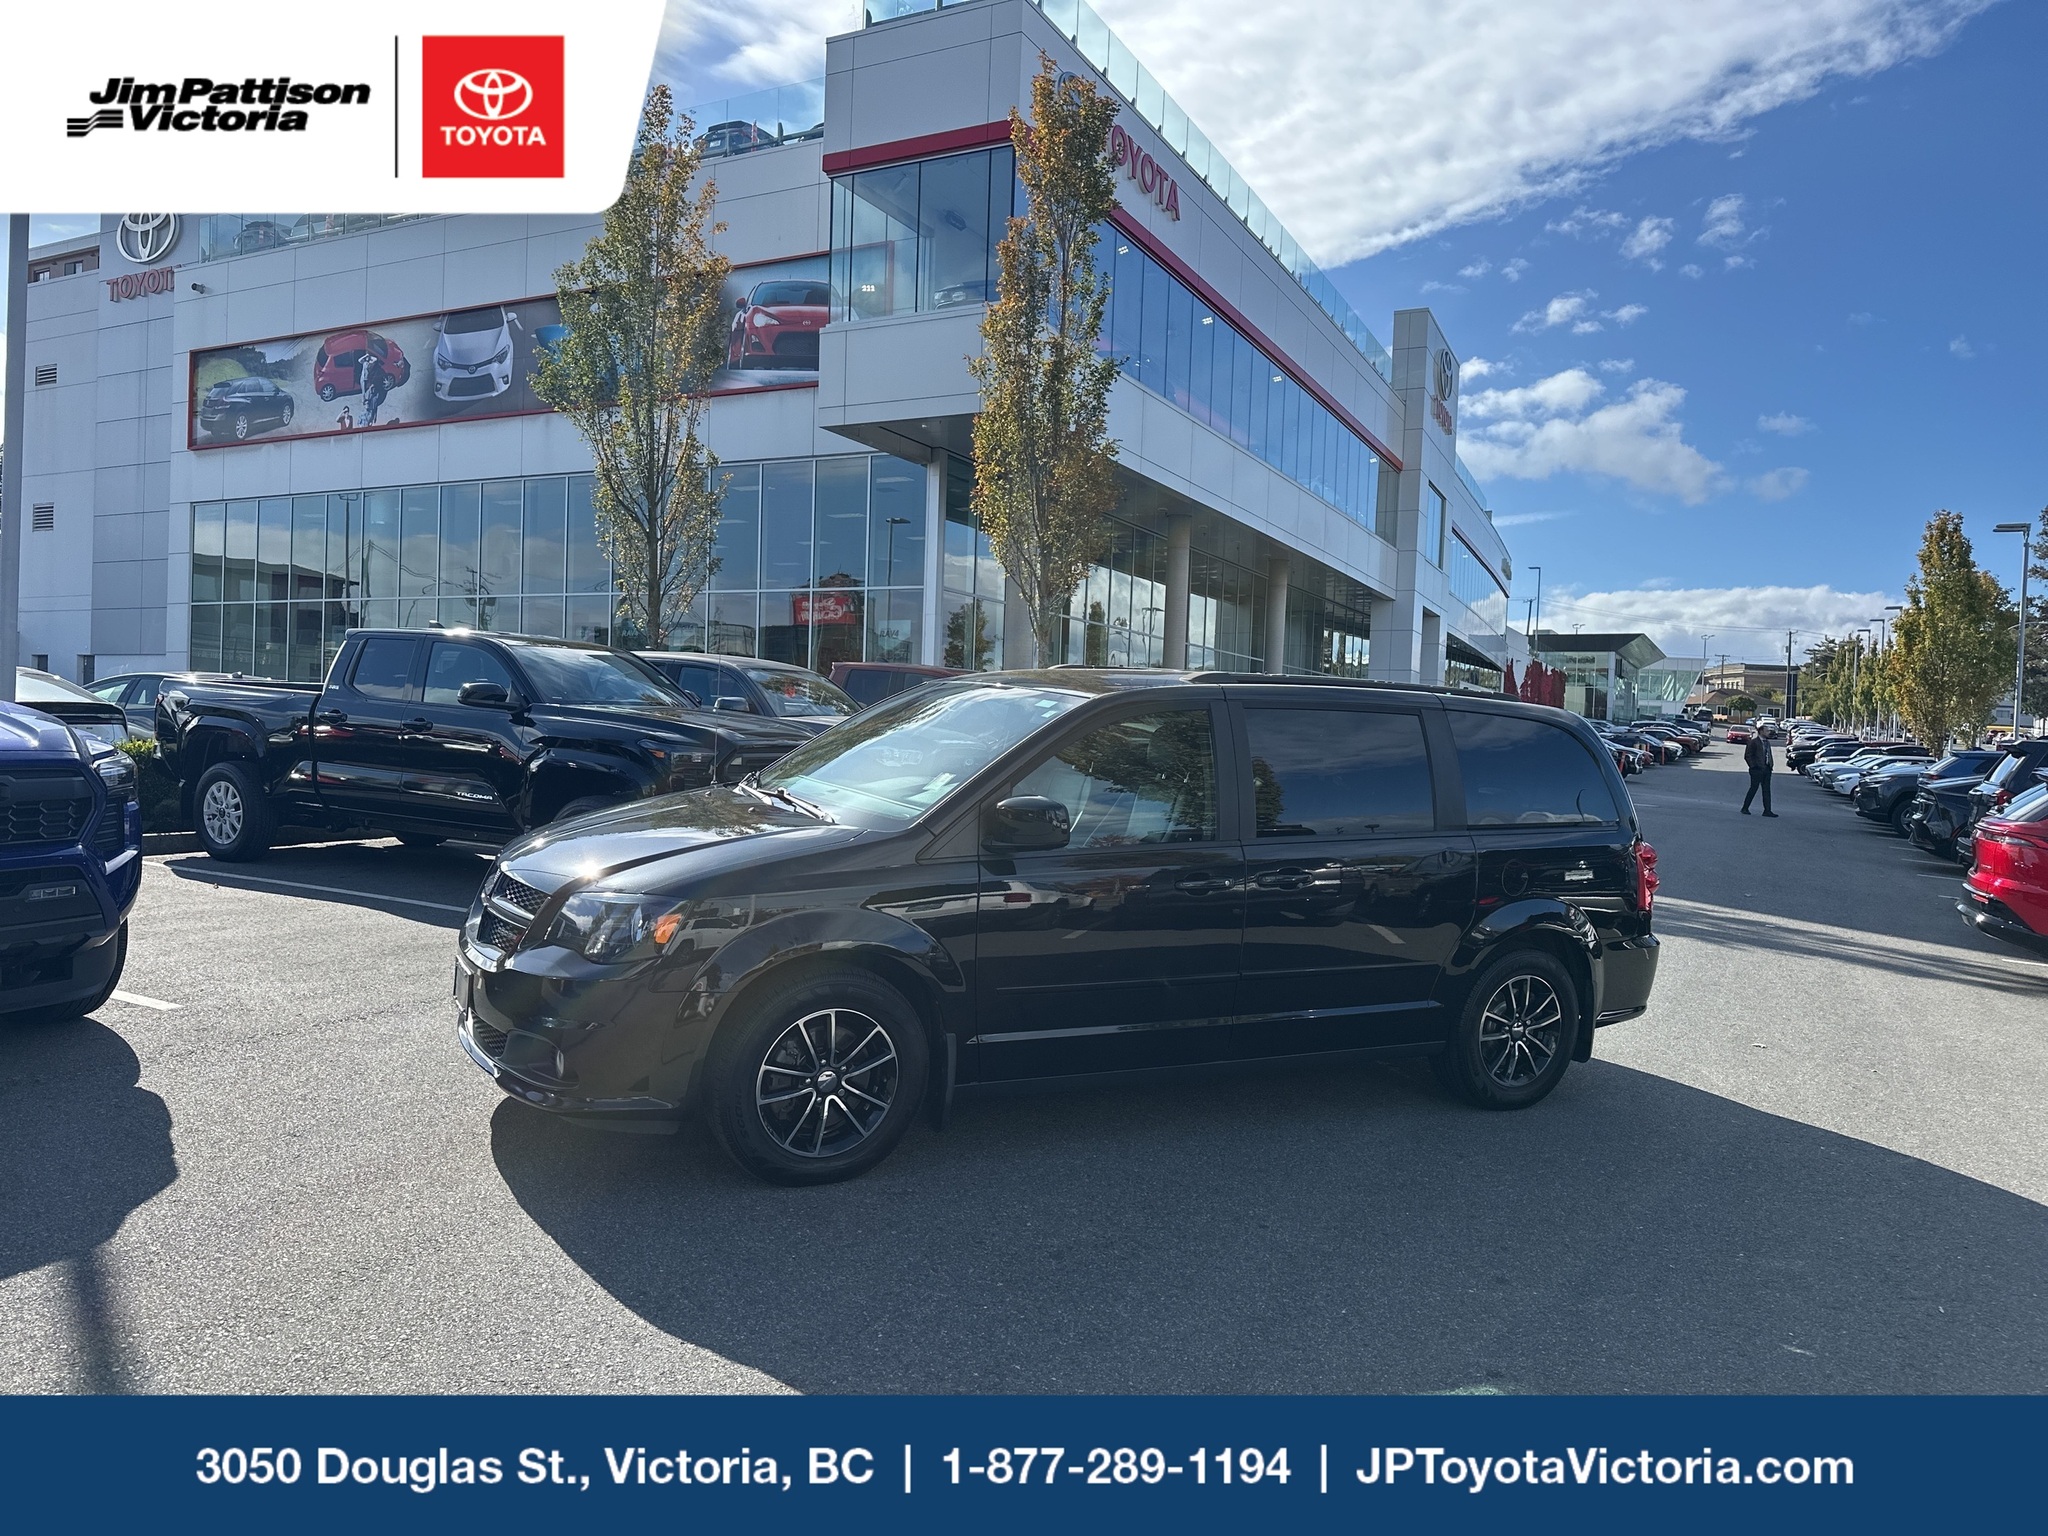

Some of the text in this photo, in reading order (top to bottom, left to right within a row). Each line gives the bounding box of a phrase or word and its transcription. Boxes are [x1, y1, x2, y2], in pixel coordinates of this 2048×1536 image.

[1109, 124, 1181, 222] OYOTA
[106, 265, 176, 303] TOYOT
[455, 790, 493, 800] TACOMA
